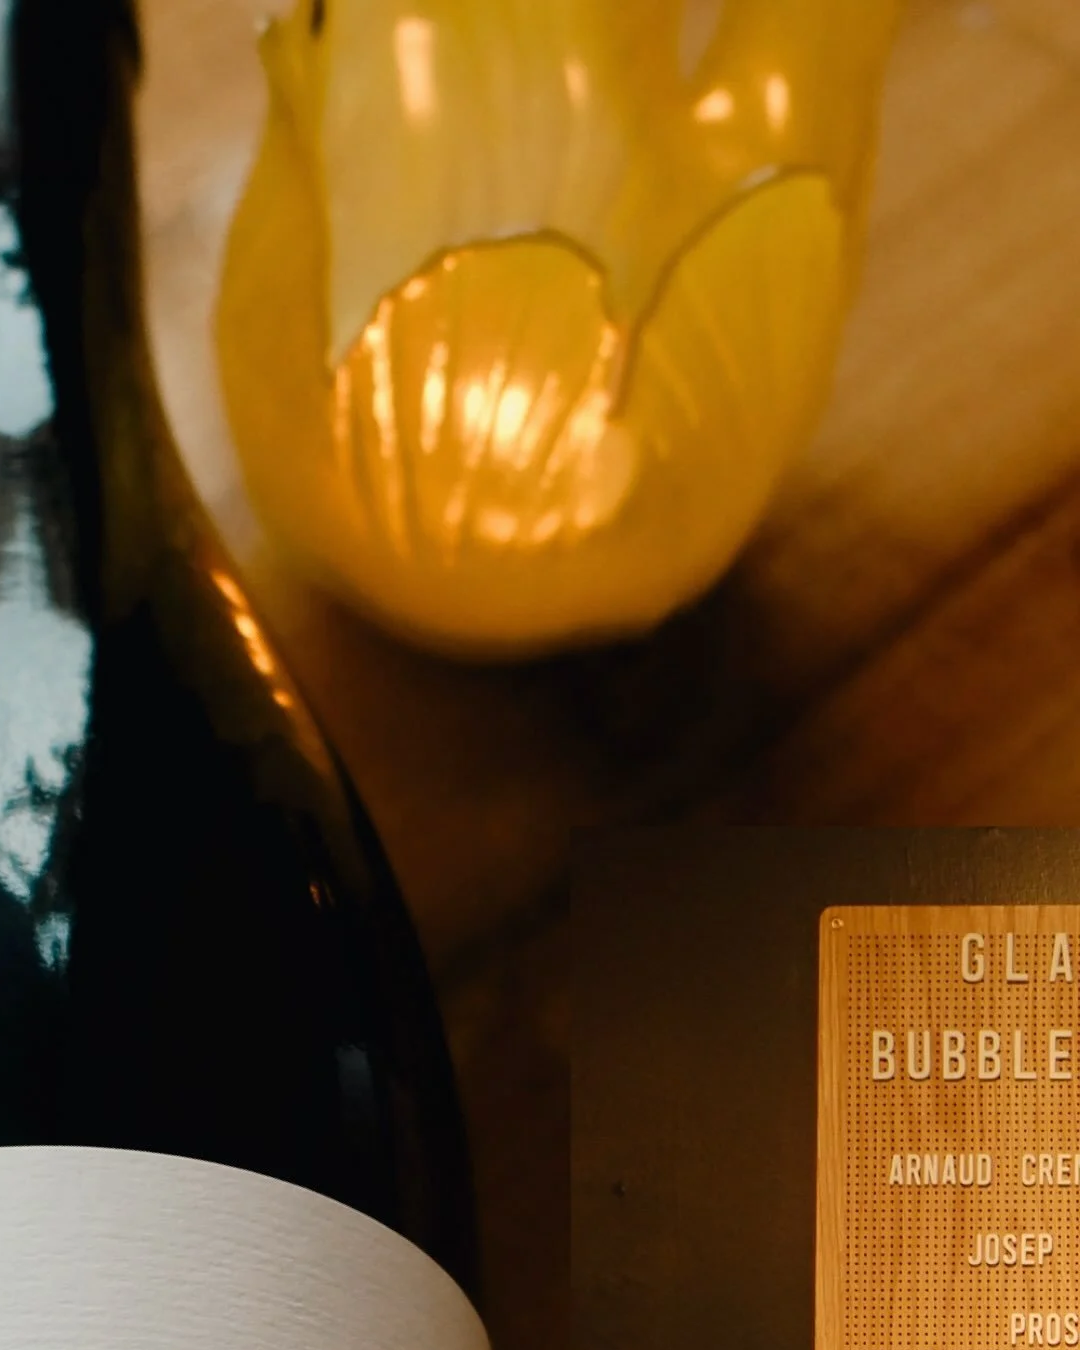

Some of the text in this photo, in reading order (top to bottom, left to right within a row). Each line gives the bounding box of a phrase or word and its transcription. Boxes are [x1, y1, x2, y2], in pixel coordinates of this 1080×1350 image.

[961, 932, 1073, 983] GLA
[872, 1030, 1072, 1081] BUBBLE
[889, 1153, 993, 1187] ARNAUD
[968, 1232, 1053, 1267] JOSEP
[1011, 1312, 1079, 1347] PROS
